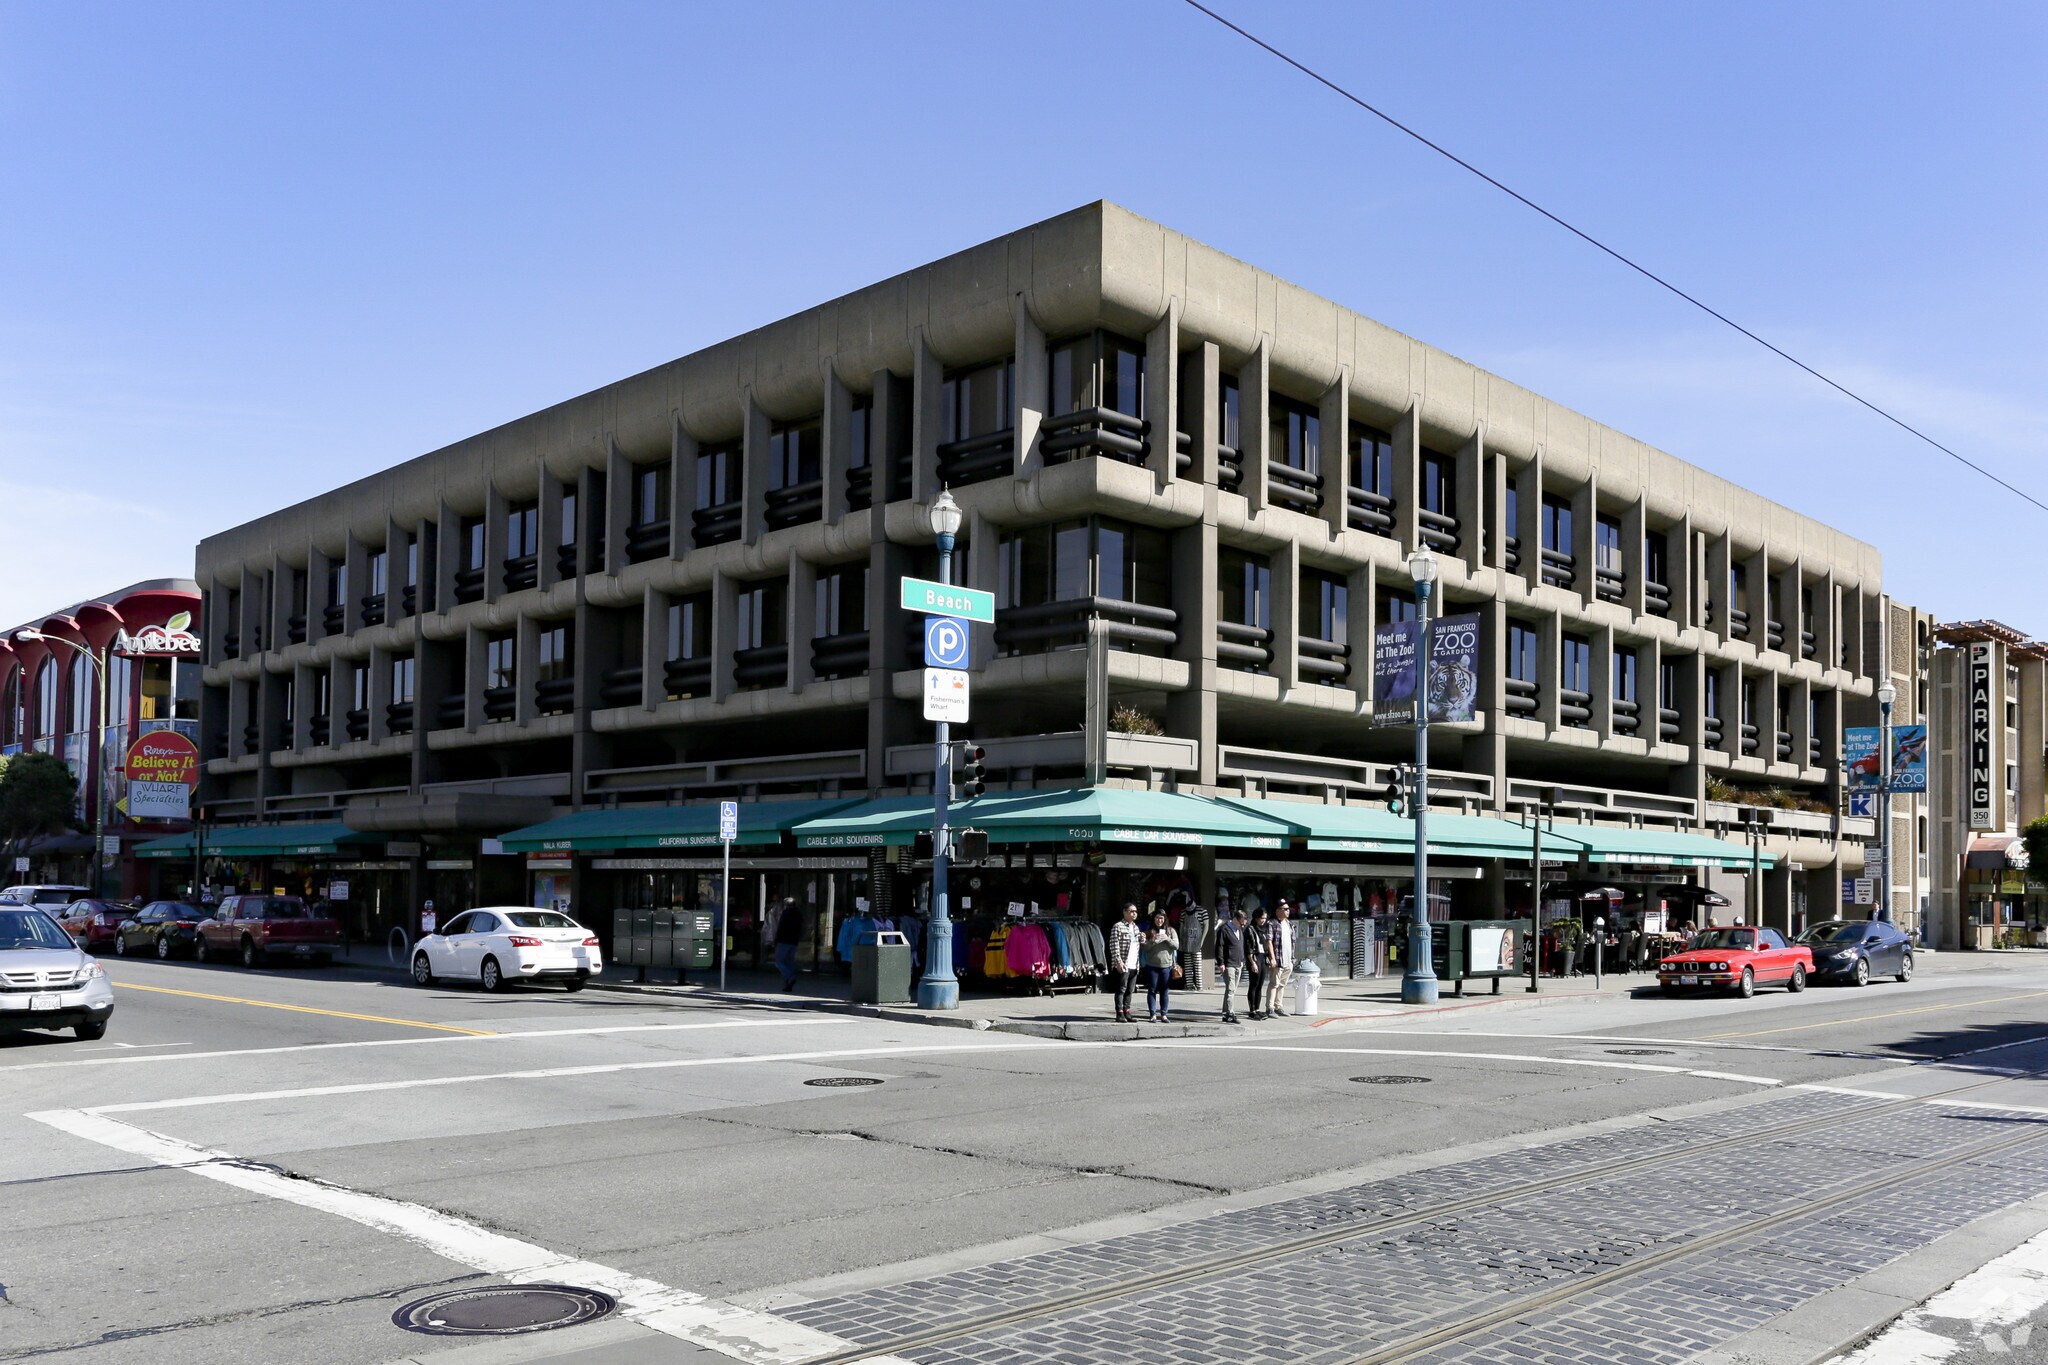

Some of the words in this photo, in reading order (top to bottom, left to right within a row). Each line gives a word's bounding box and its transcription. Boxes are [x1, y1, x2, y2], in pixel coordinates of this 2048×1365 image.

[926, 589, 972, 611] Beach
[1435, 625, 1446, 635] SAN
[1447, 623, 1476, 633] FRANCISCO
[113, 628, 201, 655] Applebee
[1376, 633, 1395, 646] Meet
[1395, 633, 1407, 643] me
[1433, 632, 1476, 651] ZOO
[1376, 650, 1384, 659] at
[1385, 646, 1398, 658] The
[1399, 643, 1415, 656] Zoo!
[1440, 647, 1475, 656] GARDENS
[930, 695, 965, 704] Fisherman's
[1374, 710, 1412, 720] www.sfzoo.org
[1847, 734, 1861, 742] Meet
[1973, 668, 1989, 803] PARKING
[1866, 742, 1879, 750] Zoo!
[131, 755, 179, 768] Believe
[182, 755, 195, 769] It
[139, 773, 154, 781] or
[156, 770, 185, 782] Not!
[1893, 773, 1925, 784] ZOO
[141, 783, 183, 795] WHARF
[133, 790, 185, 805] Specialties
[1973, 811, 1989, 820] 350
[1069, 829, 1094, 838] FOOD
[1113, 828, 1140, 839] CABLE
[1143, 830, 1160, 840] CAR
[1162, 831, 1203, 843] SOUVENIRS
[543, 841, 556, 850] NALA
[658, 837, 689, 846] CALIFORNIA
[690, 836, 717, 845] SUNSHINE
[806, 837, 828, 846] CABLE
[830, 836, 844, 845] CAR
[846, 834, 884, 845] SOUVENIRS
[1250, 837, 1281, 847] T-SHIRTS
